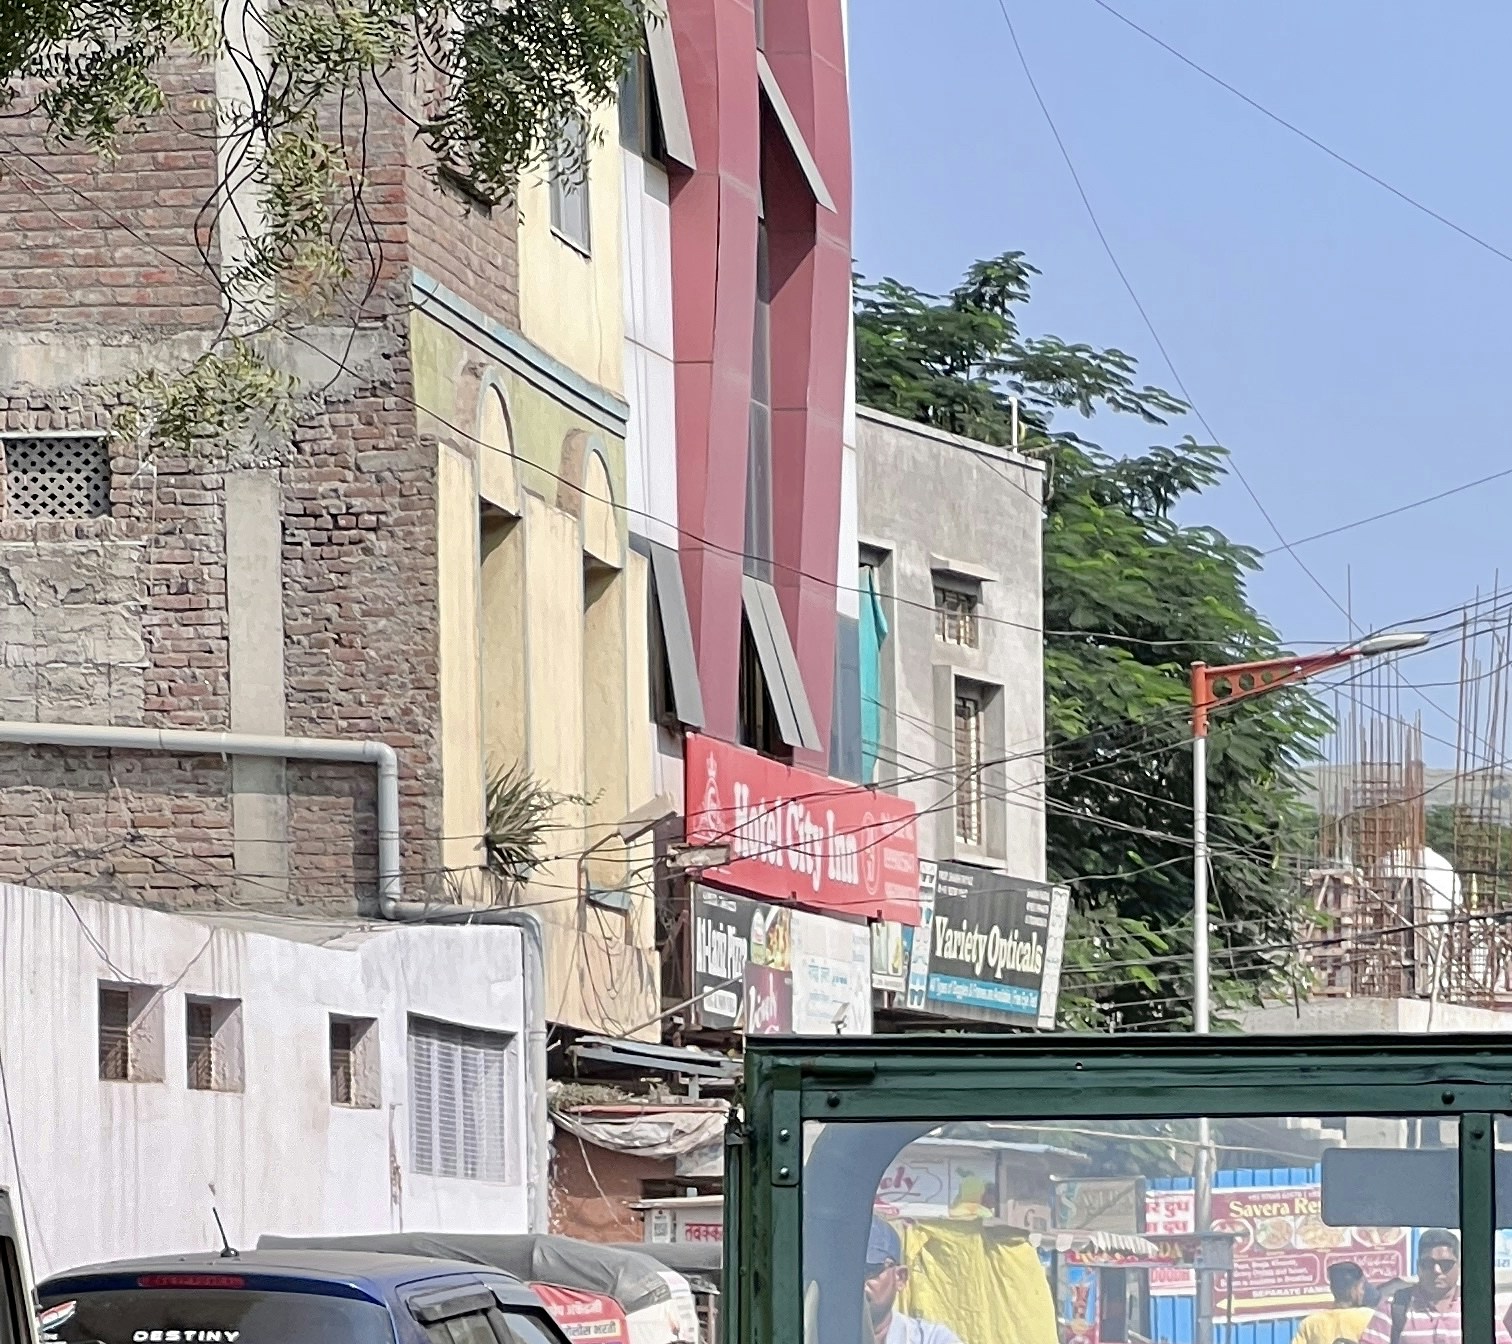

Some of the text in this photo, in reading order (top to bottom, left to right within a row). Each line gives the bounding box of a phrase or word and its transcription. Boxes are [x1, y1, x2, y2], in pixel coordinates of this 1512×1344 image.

[733, 781, 784, 867] Hotel
[786, 799, 823, 892] City
[826, 809, 859, 885] Inn
[935, 915, 1044, 980] Variety Opticals
[1229, 1198, 1321, 1218] Savera Re
[1252, 1287, 1301, 1298] SEPARATE
[132, 1330, 240, 1342] DESTINY
